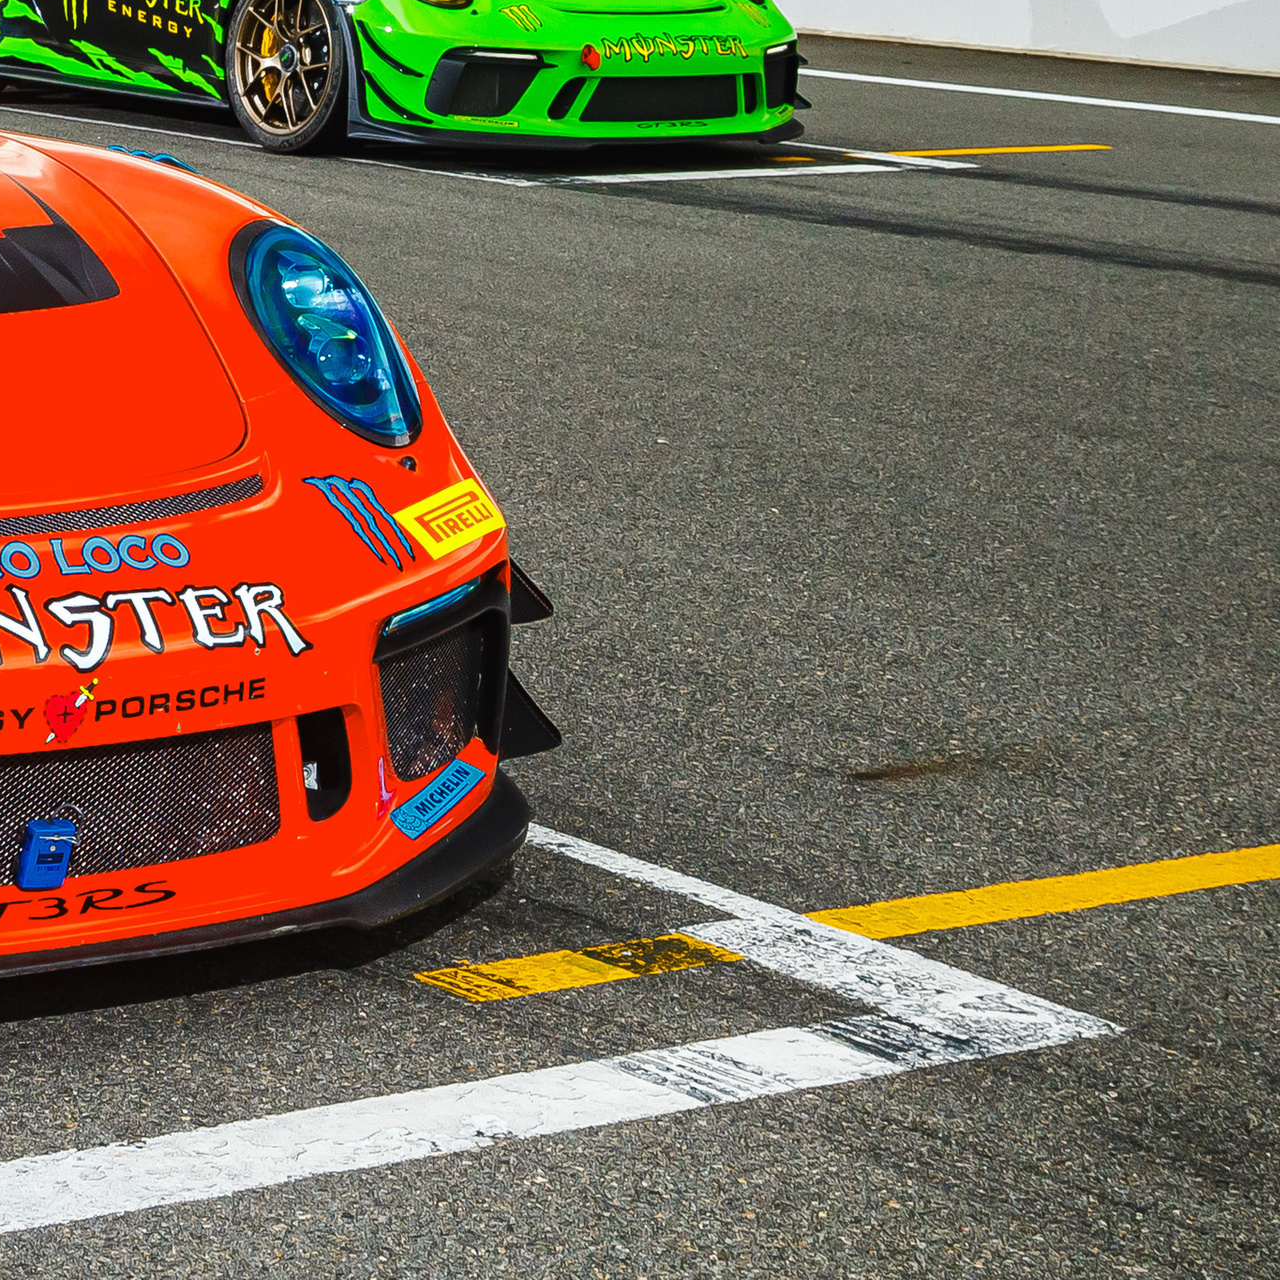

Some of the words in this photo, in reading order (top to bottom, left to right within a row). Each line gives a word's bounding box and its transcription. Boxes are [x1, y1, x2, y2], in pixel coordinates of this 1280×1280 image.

[107, 0, 193, 39] ENERGY
[414, 490, 494, 544] PIRELLI
[50, 533, 191, 575] LOCO
[95, 678, 268, 721] PORSCHE
[414, 765, 472, 818] MICHELIN
